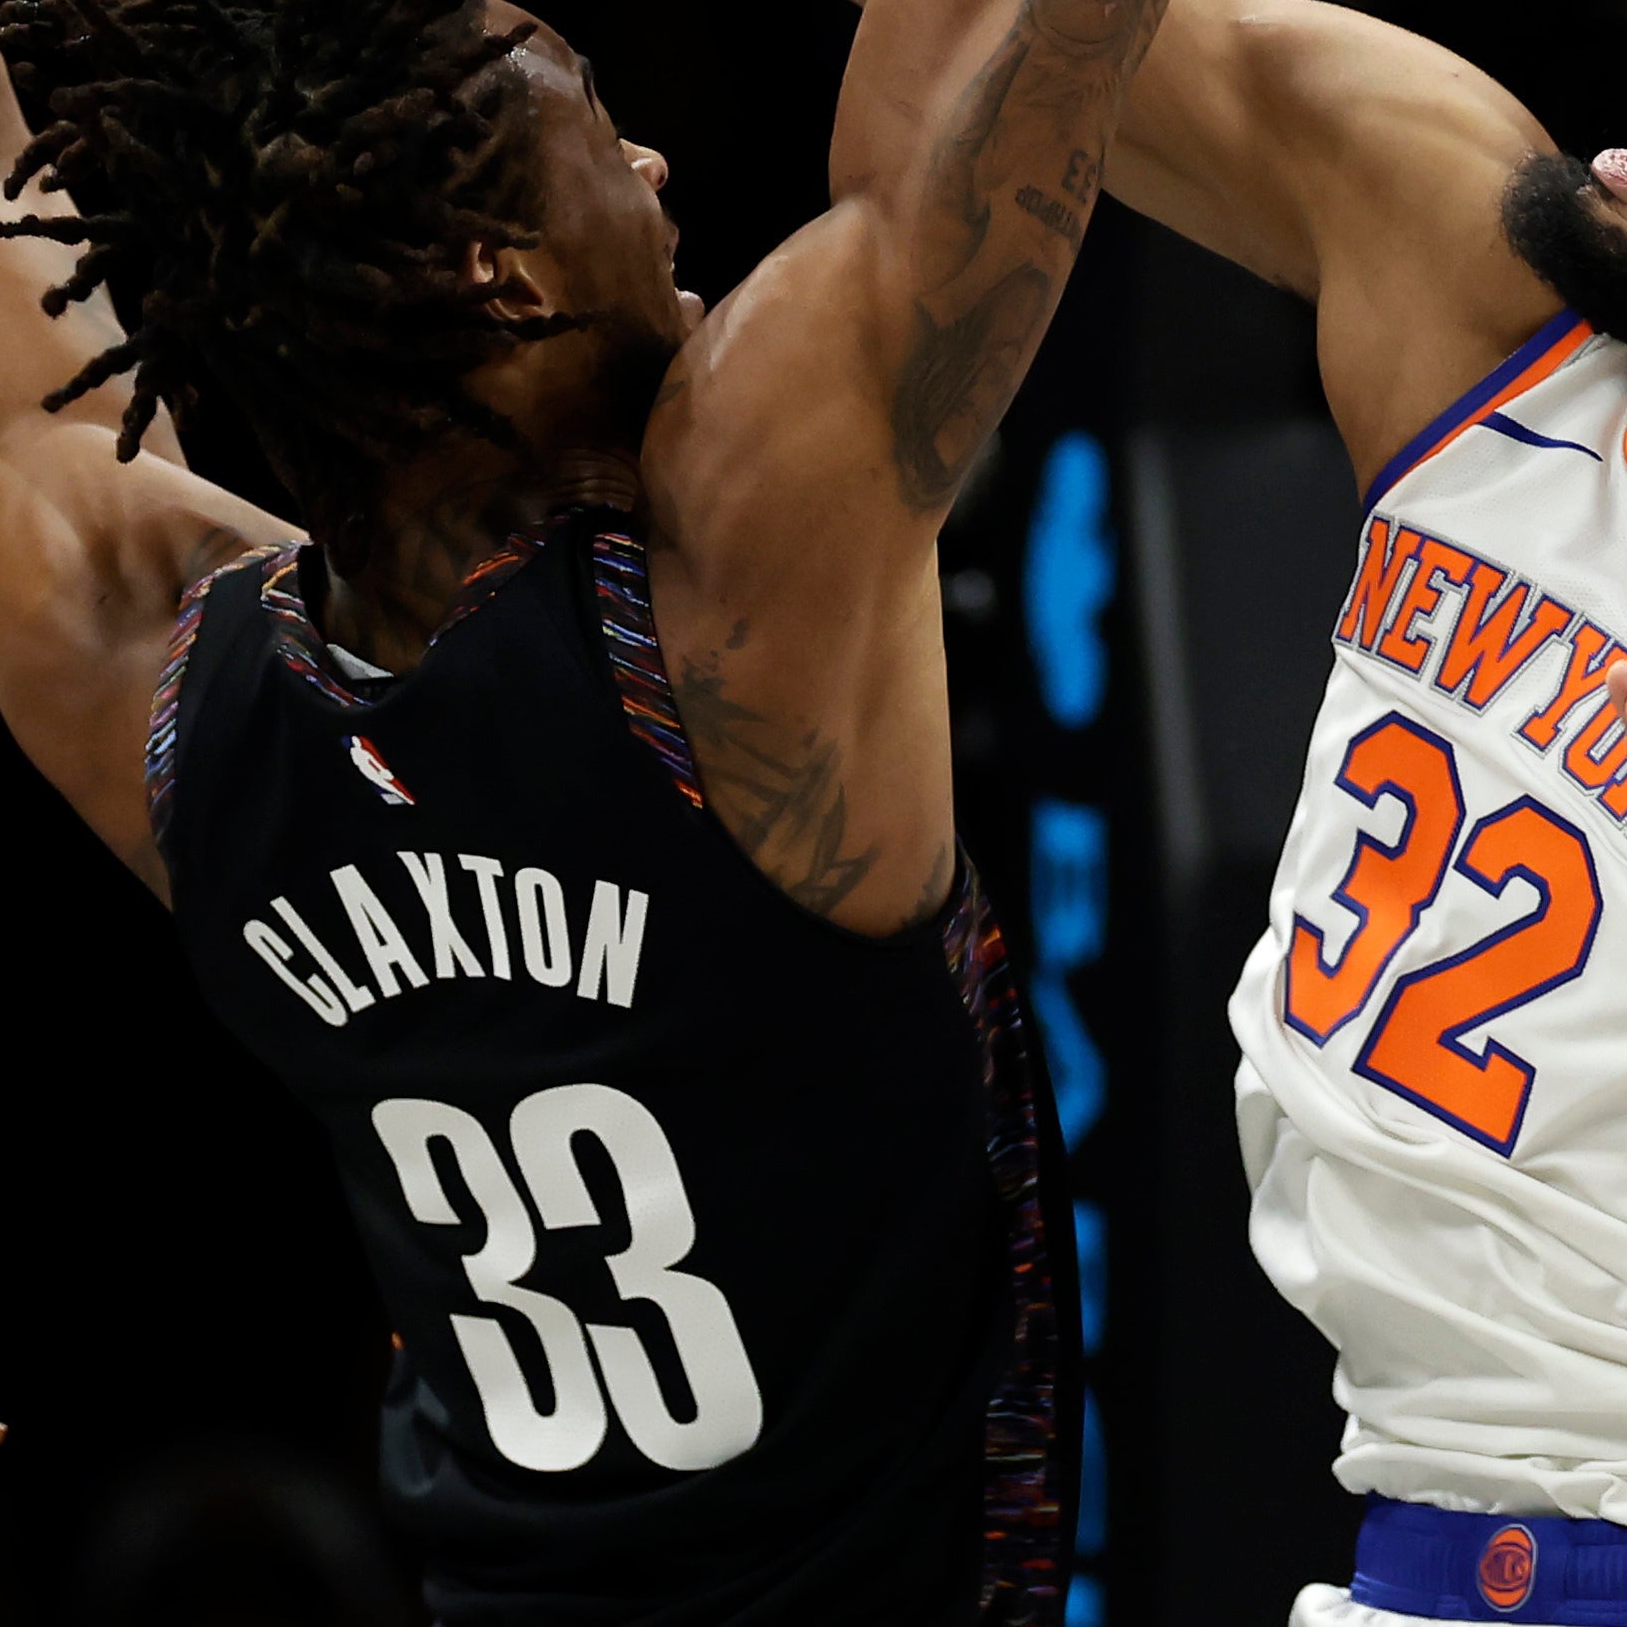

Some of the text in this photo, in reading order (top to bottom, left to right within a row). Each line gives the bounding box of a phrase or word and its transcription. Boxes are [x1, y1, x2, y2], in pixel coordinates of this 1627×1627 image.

[1333, 514, 1577, 714] NEW
[242, 850, 649, 1027] CLAXTON
[1282, 710, 1604, 1160] 32
[372, 1082, 763, 1472] 33
